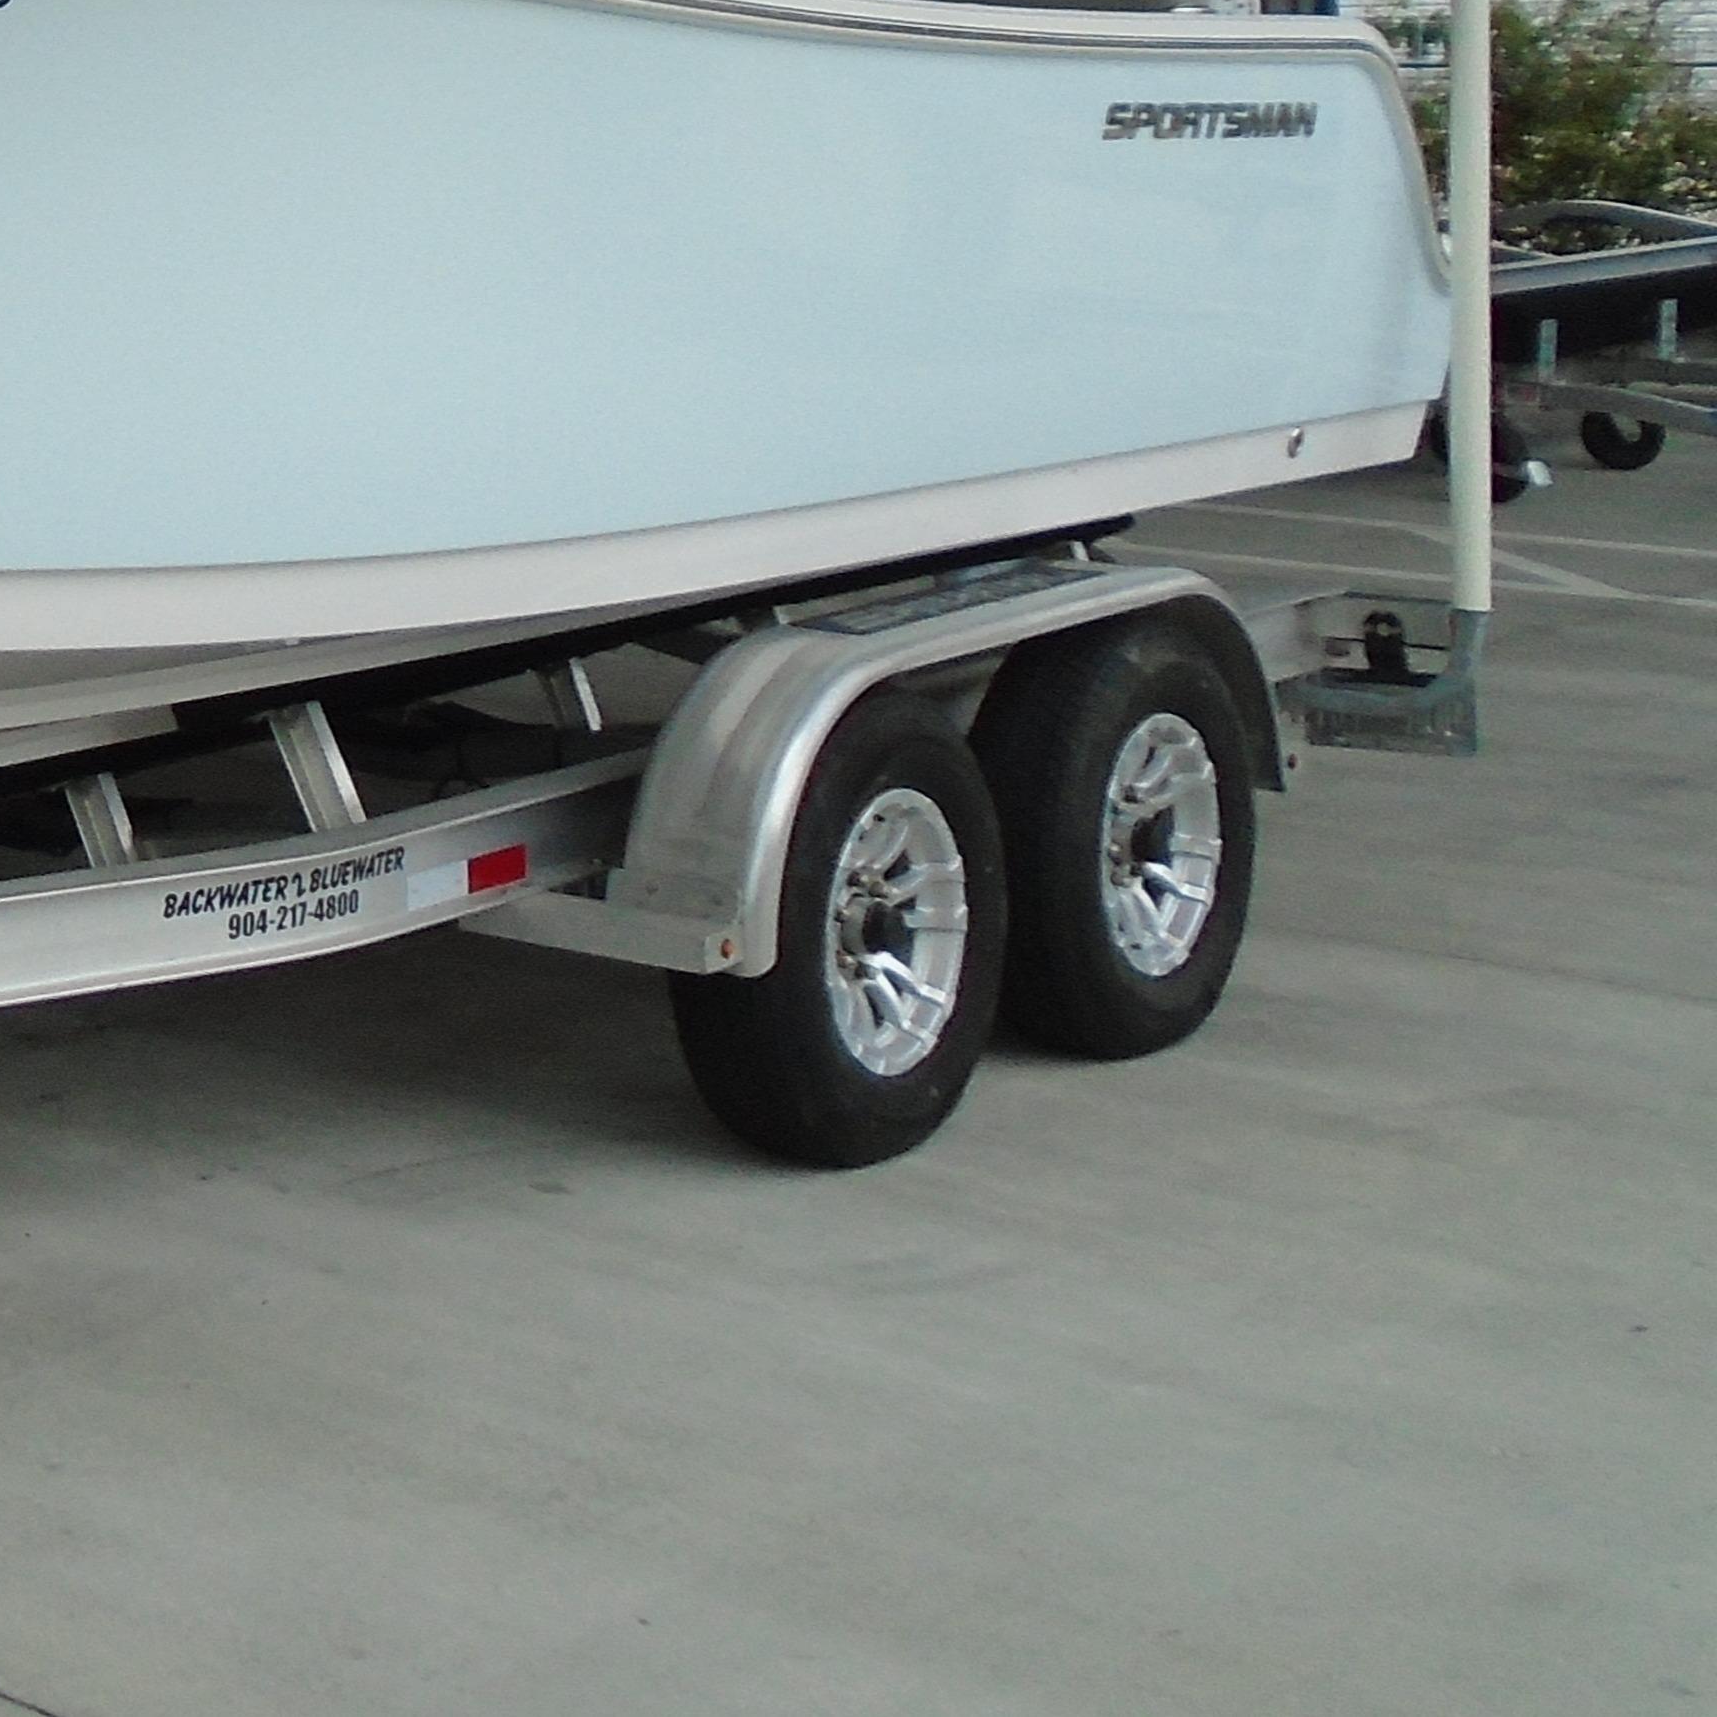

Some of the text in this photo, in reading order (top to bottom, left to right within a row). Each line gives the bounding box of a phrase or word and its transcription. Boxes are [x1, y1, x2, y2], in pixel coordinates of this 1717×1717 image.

[1102, 102, 1318, 140] SPORTSMAN
[163, 875, 289, 919] BACKWATER
[309, 846, 406, 893] BLUEWATER
[228, 889, 359, 940] 904-217-4800
